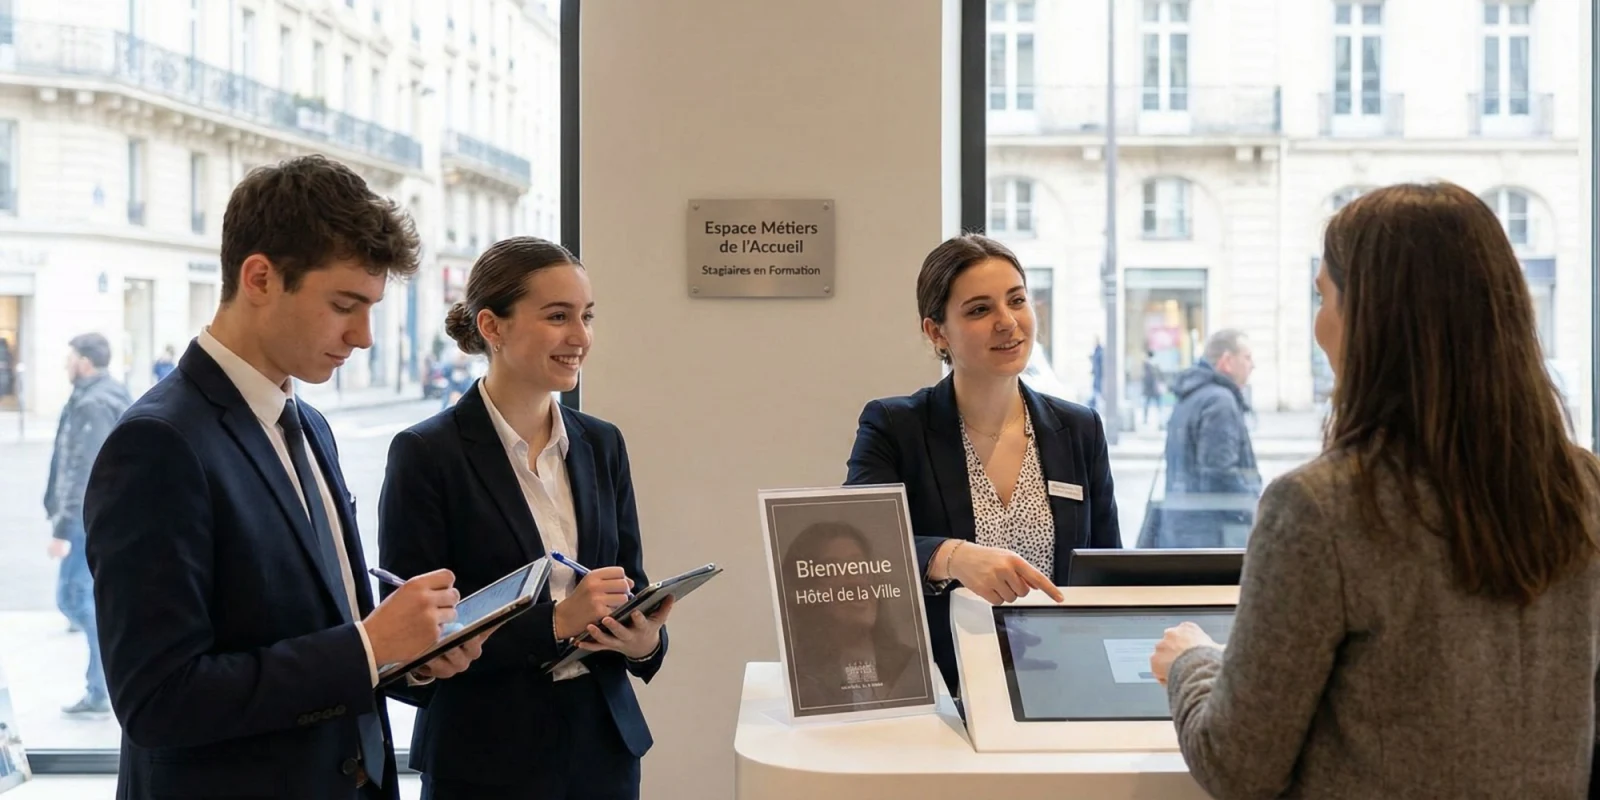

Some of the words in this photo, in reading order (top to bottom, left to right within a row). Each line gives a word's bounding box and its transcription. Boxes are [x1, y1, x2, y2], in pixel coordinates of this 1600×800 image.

[705, 221, 757, 237] Espace
[761, 221, 818, 235] Métiers
[719, 240, 738, 253] de
[742, 240, 803, 253] l’Accueil
[702, 265, 751, 277] Stagiaires
[753, 267, 766, 275] en
[769, 265, 820, 275] Formation
[796, 560, 892, 578] Bienvenue
[796, 588, 834, 604] Hôtel
[837, 587, 854, 601] de
[857, 586, 869, 600] la
[871, 584, 901, 599] Ville
